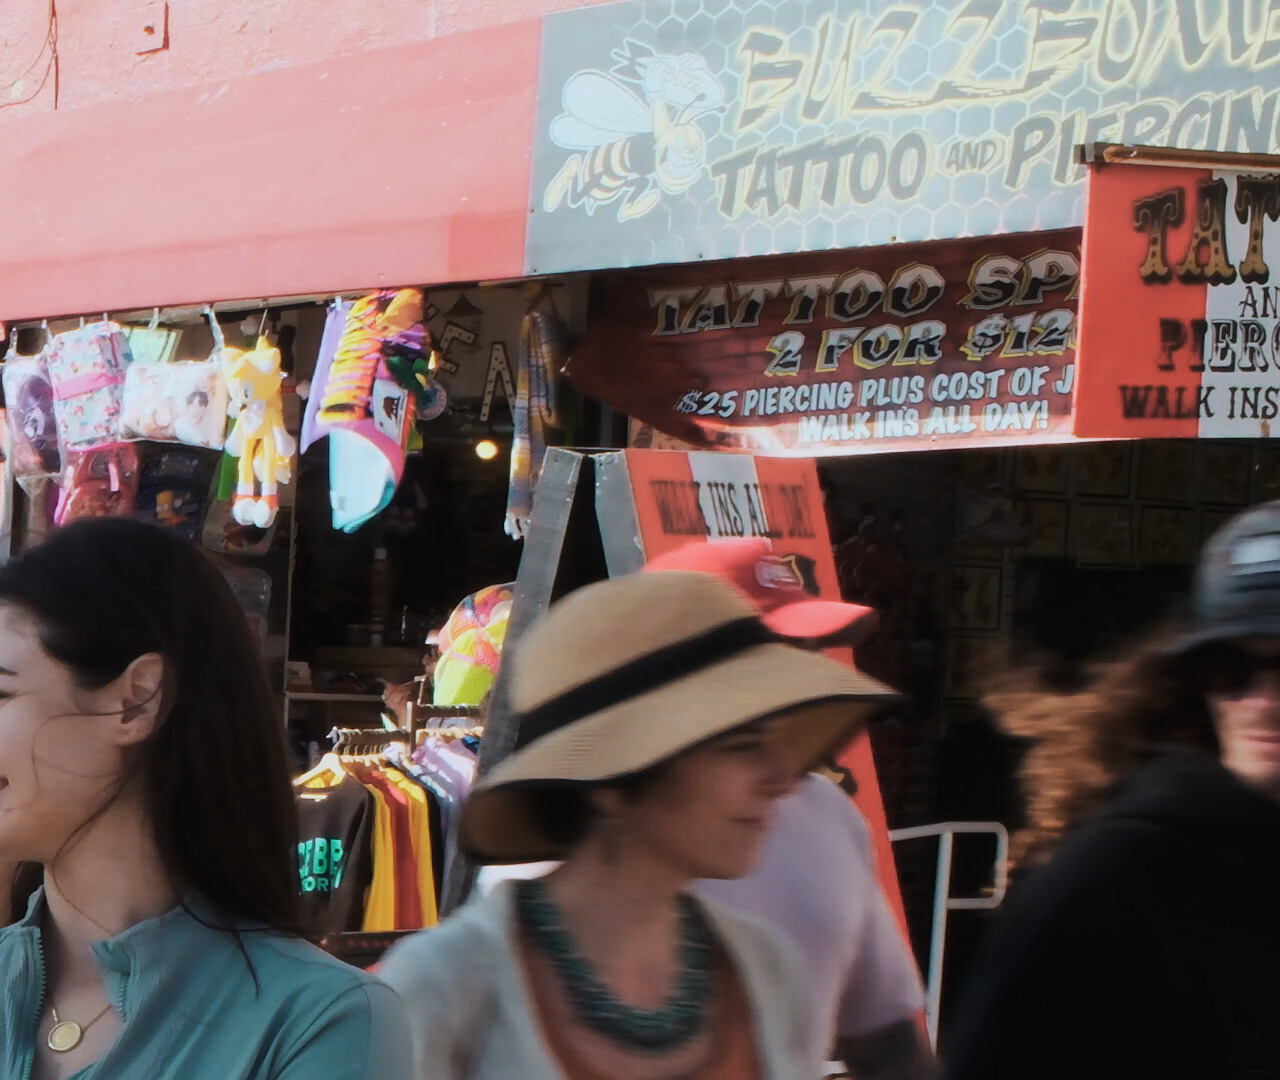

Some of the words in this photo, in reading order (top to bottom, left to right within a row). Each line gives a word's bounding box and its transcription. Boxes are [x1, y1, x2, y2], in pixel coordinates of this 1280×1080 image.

[710, 132, 928, 218] TATTOO
[945, 139, 998, 173] AND
[1004, 90, 1280, 188] PIERCIN
[647, 262, 945, 335] TATTOO
[958, 247, 1081, 311] SP
[764, 330, 806, 376] 2
[815, 320, 946, 372] FOR
[959, 309, 1078, 360] $12
[675, 388, 739, 417] $25
[741, 381, 854, 416] PIERCING
[858, 374, 925, 406] PLUS
[929, 369, 1005, 400] COST
[1008, 366, 1050, 395] OF
[1118, 384, 1216, 420] WALK
[800, 412, 870, 442] WALK
[924, 405, 977, 434] ALL
[982, 400, 1050, 431] DAY!
[707, 481, 744, 537] INS
